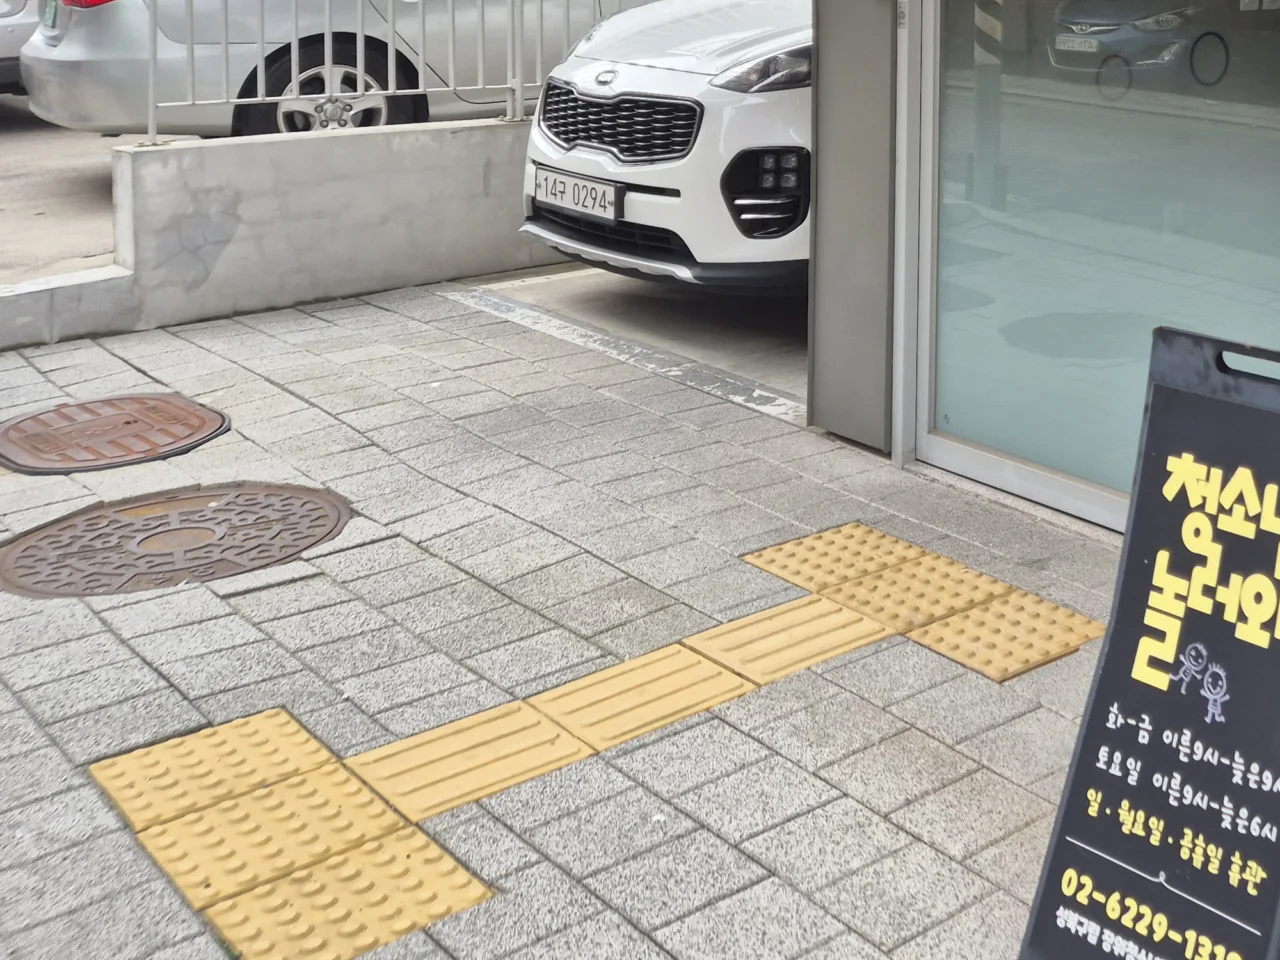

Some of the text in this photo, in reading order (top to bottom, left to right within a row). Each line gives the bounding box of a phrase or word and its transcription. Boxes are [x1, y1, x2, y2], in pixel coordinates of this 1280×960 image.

[543, 175, 608, 213] 14구 0294
[1105, 702, 1153, 745] 화-금
[1095, 745, 1142, 786] 토요일
[1227, 850, 1268, 896] 휴관
